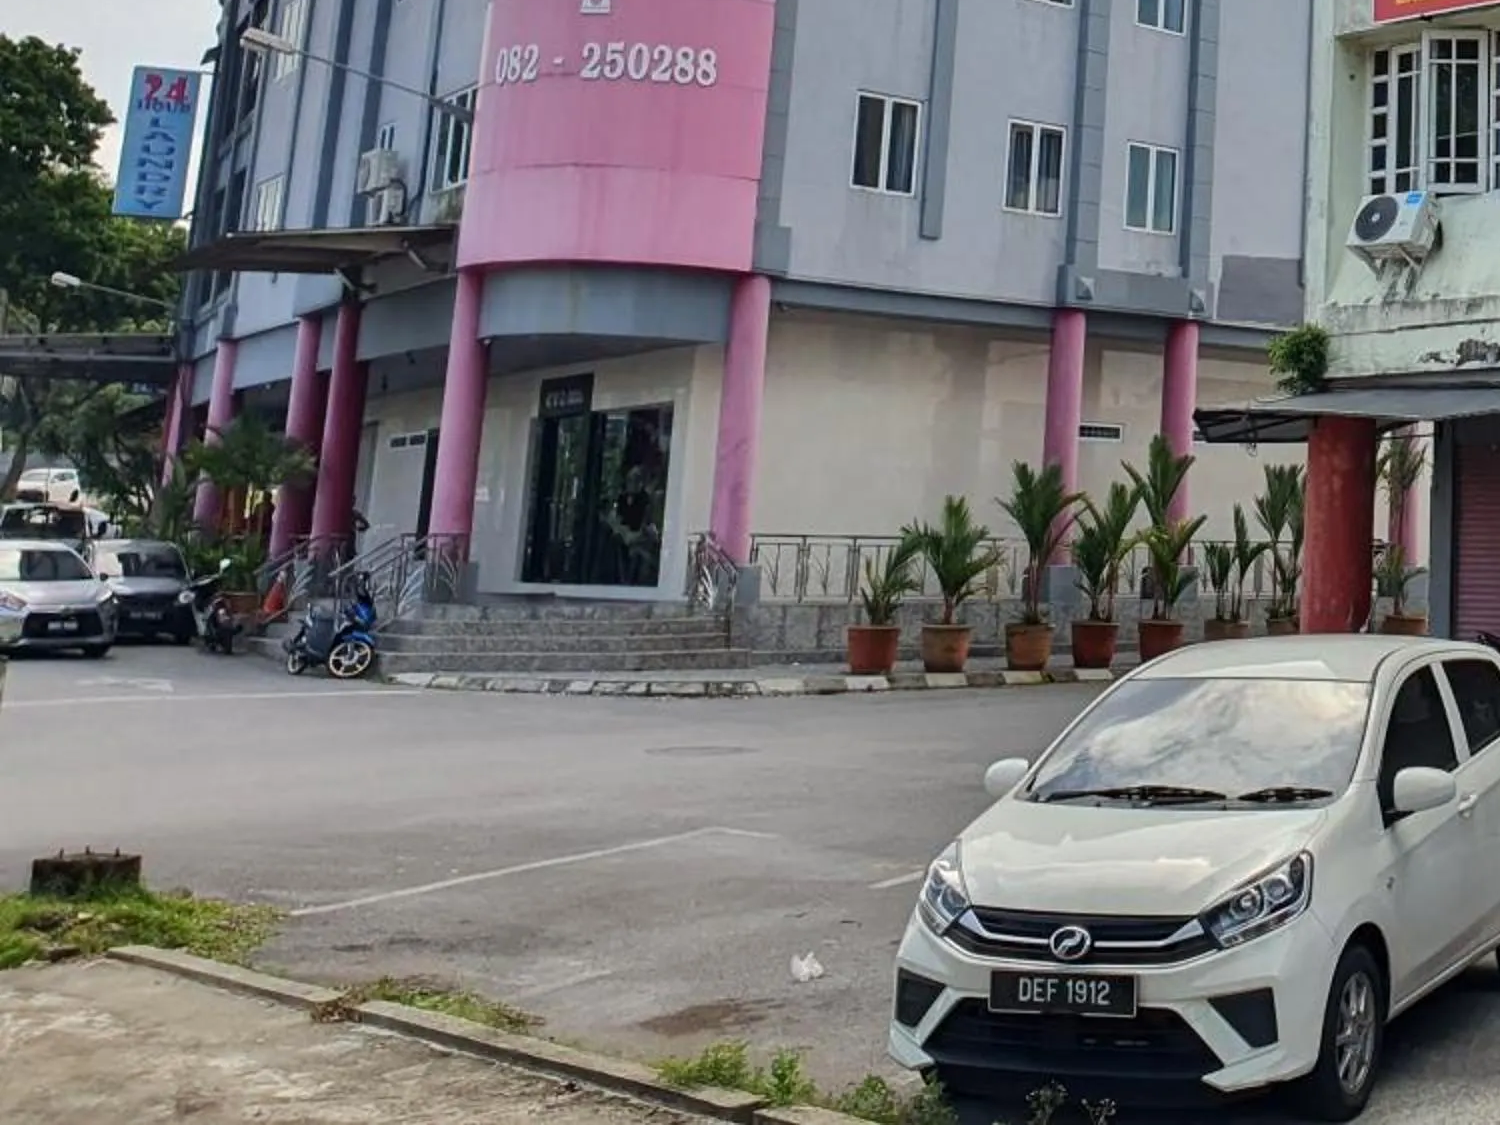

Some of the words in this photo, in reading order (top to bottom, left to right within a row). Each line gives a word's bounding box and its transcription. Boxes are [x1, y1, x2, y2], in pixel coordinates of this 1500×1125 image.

[494, 42, 540, 86] 082
[579, 40, 718, 86] 250288
[144, 73, 189, 104] 24
[134, 117, 176, 210] LAUNDRY
[1018, 977, 1060, 1003] DEF
[1065, 979, 1112, 1006] 1912
